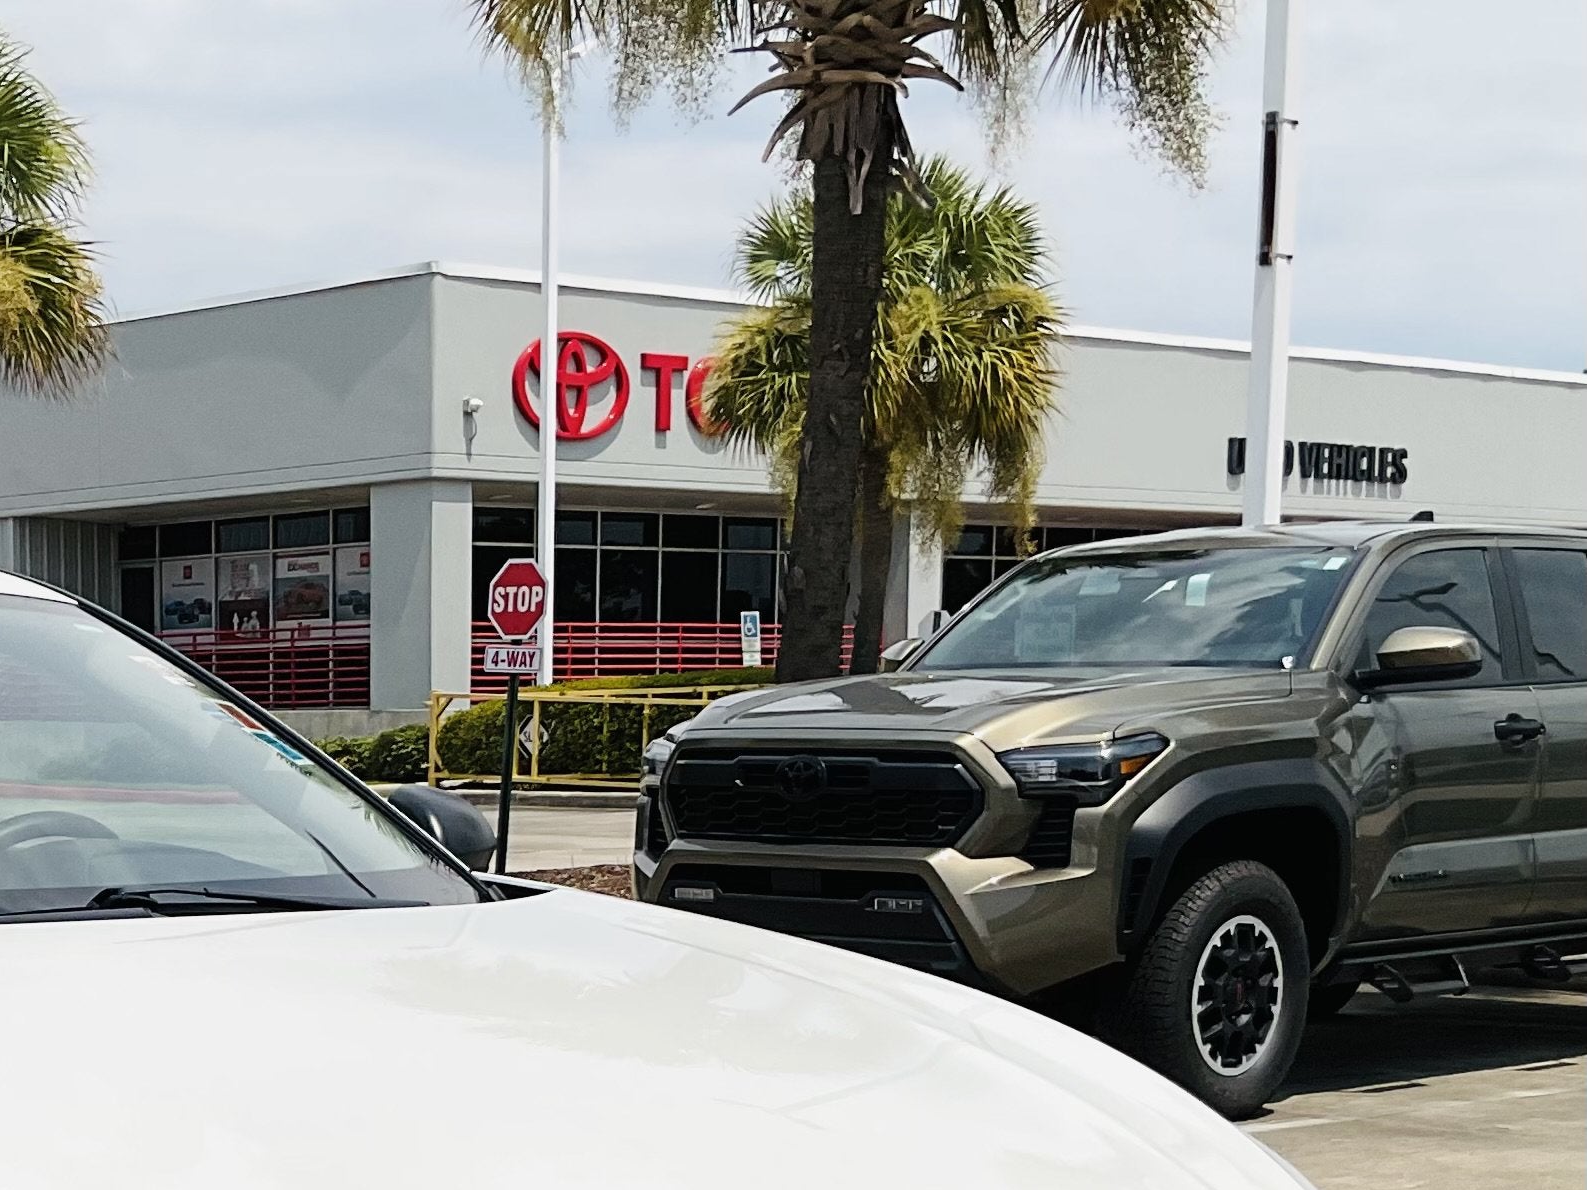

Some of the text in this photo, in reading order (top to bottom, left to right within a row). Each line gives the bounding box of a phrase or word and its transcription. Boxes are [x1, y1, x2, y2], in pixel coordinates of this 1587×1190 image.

[1227, 437, 1408, 484] UD VEHICLES
[493, 585, 543, 613] STOP
[491, 650, 536, 668] 4-WAY
